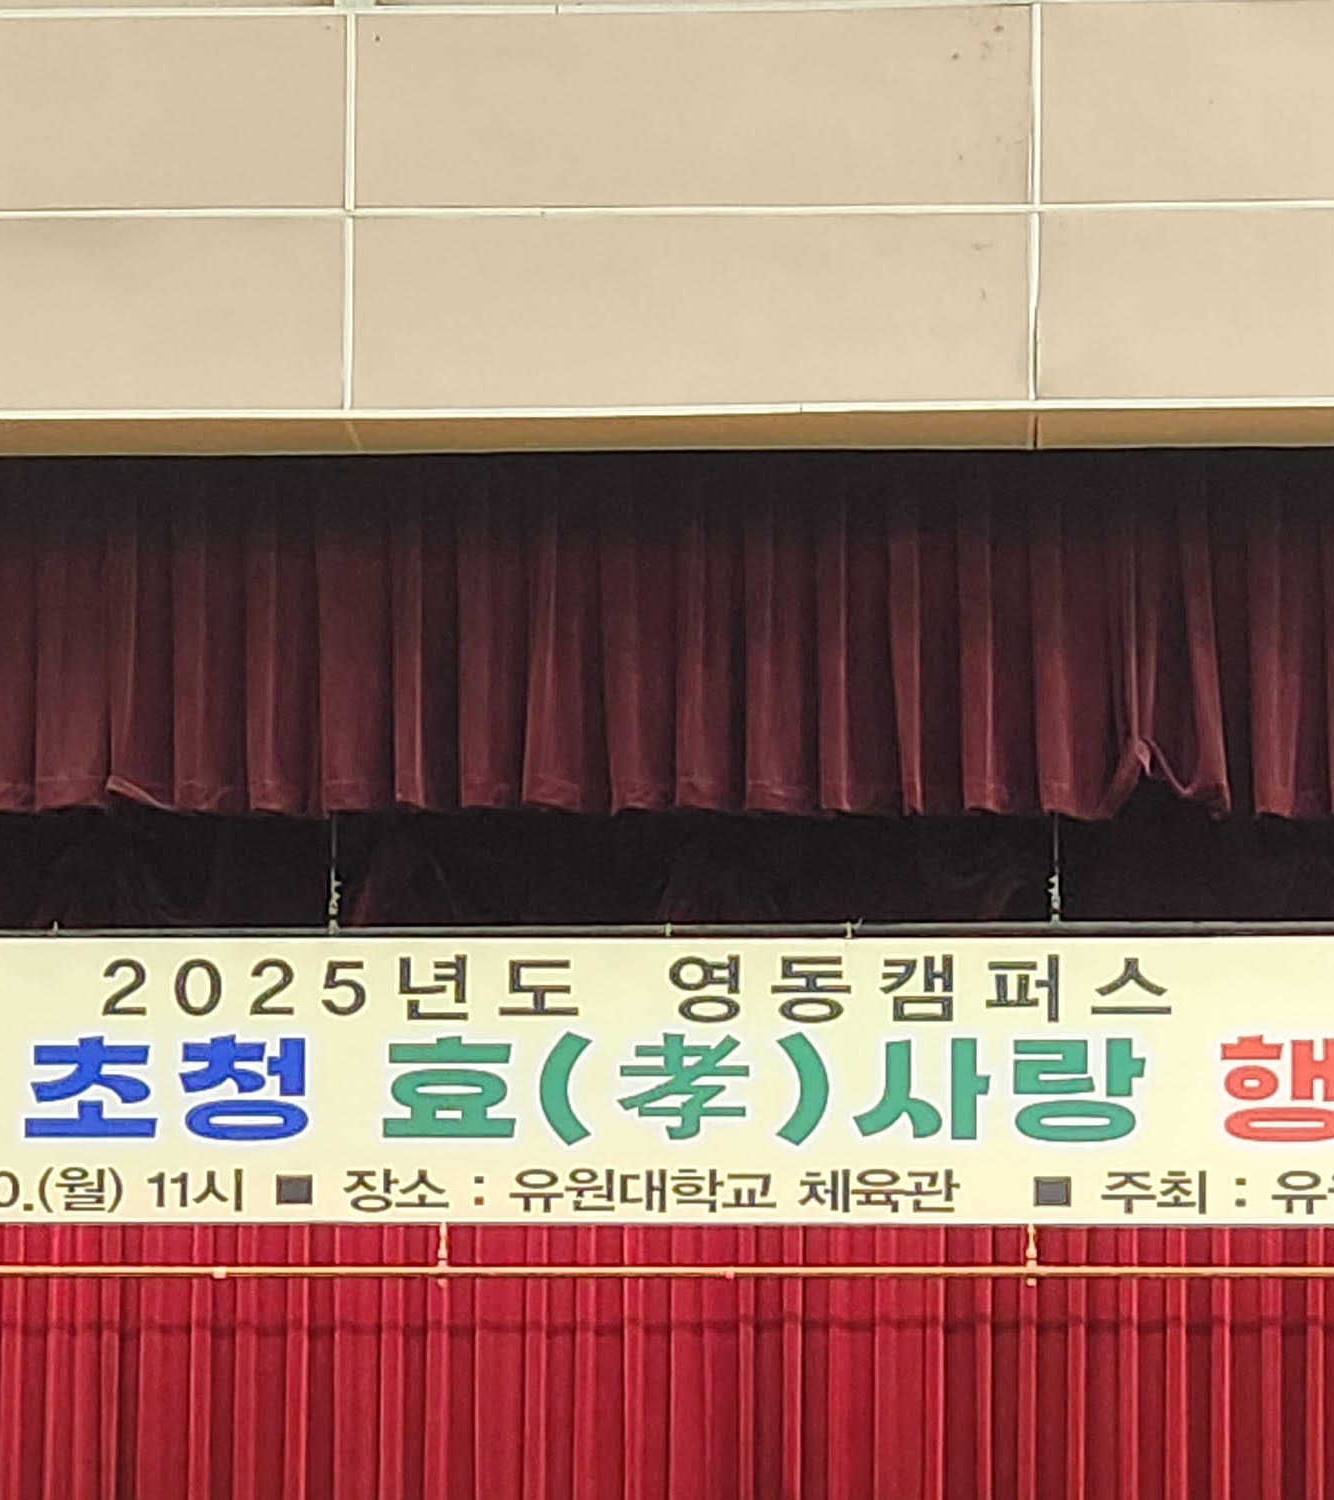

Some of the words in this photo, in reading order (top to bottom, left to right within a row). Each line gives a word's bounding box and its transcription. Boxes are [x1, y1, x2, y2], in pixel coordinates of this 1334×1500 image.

[102, 954, 579, 1021] 2025년도
[669, 954, 1172, 1023] 영동캠퍼스
[25, 1034, 309, 1141] 초청
[382, 1032, 1146, 1146] 효(孝)사랑
[147, 1169, 243, 1212] 11시
[343, 1168, 449, 1213] 장소
[509, 1168, 777, 1213] 유원대학교
[798, 1169, 960, 1213] 체육관
[1101, 1170, 1206, 1214] 주최
